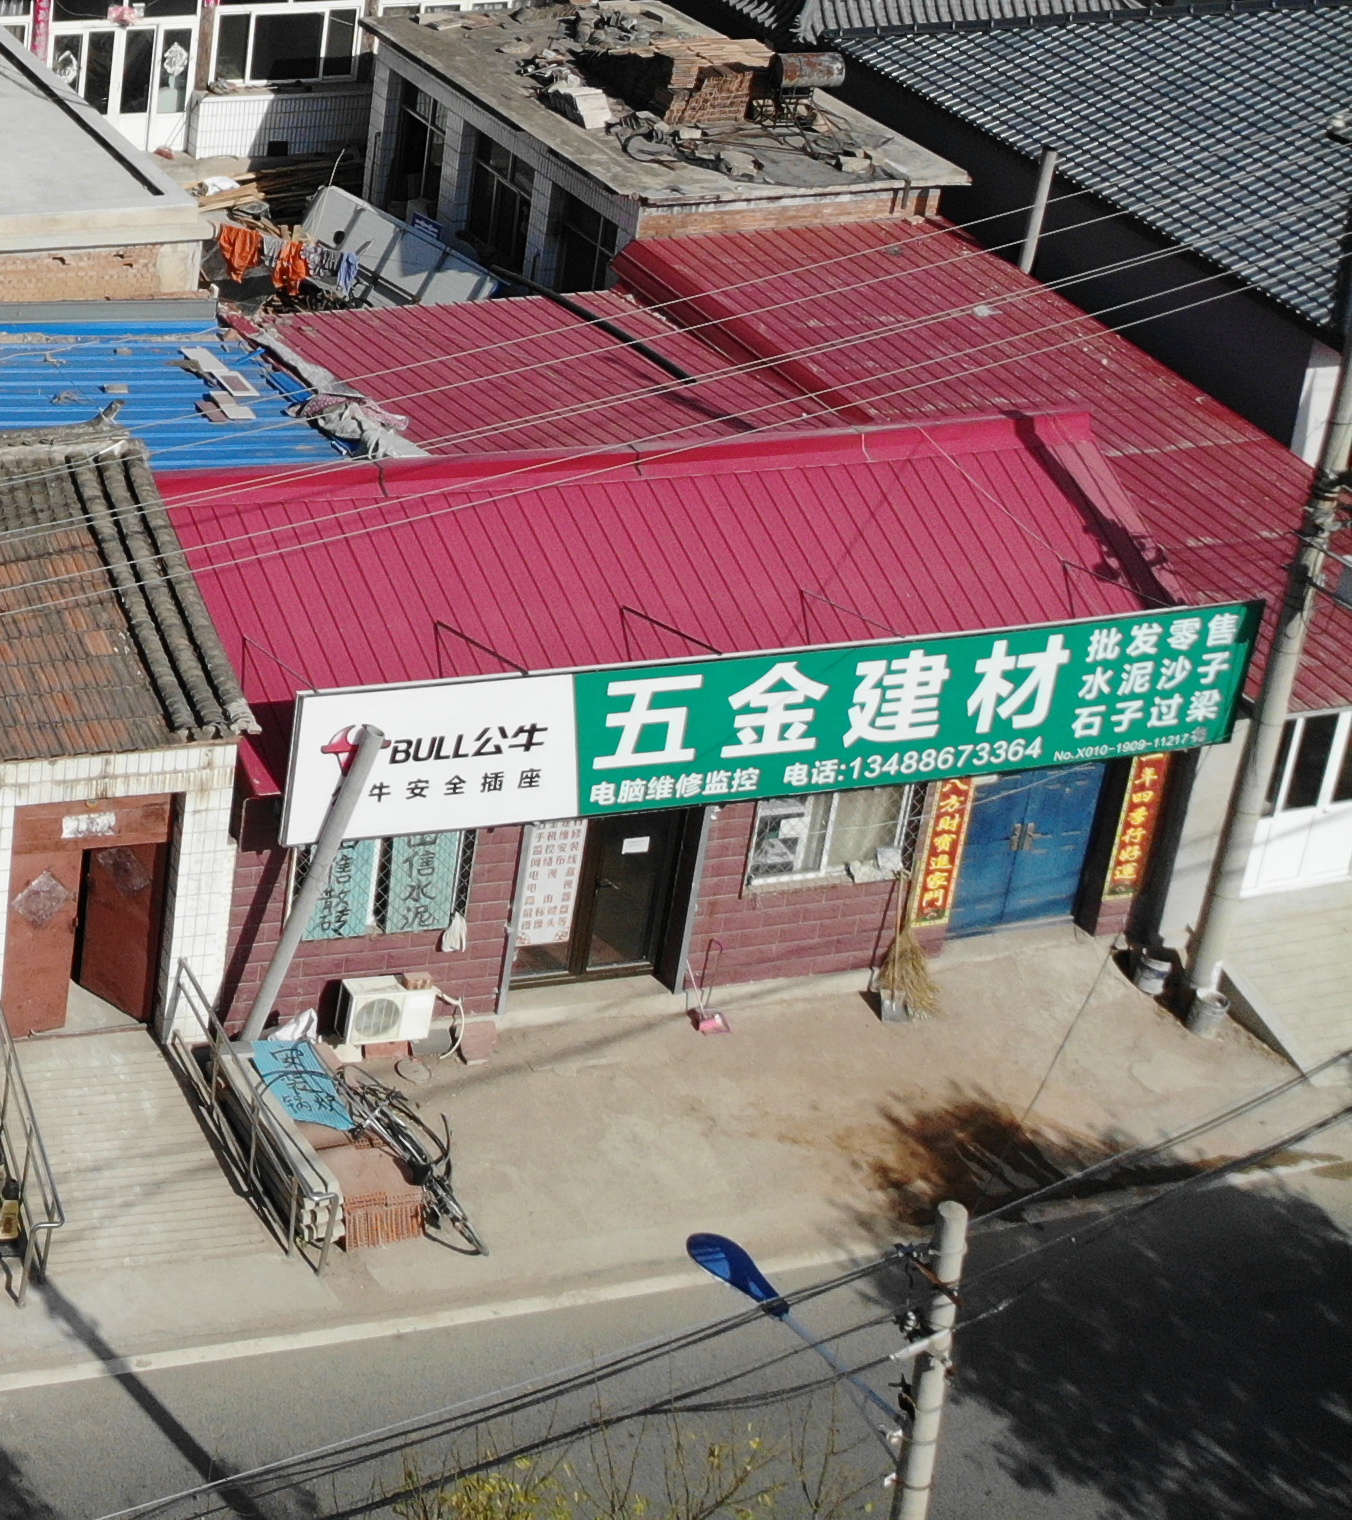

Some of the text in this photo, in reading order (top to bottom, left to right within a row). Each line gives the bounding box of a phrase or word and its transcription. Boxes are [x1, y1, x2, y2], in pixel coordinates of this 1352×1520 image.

[1085, 612, 1240, 663] 批发零售
[1078, 651, 1231, 701] 水泥沙子
[593, 634, 1072, 770] 五金建材
[1071, 688, 1222, 739] 石子过梁
[389, 723, 549, 764] BULL公牛
[332, 768, 542, 809] 牛安全插座
[590, 766, 761, 806] 电脑维修监控
